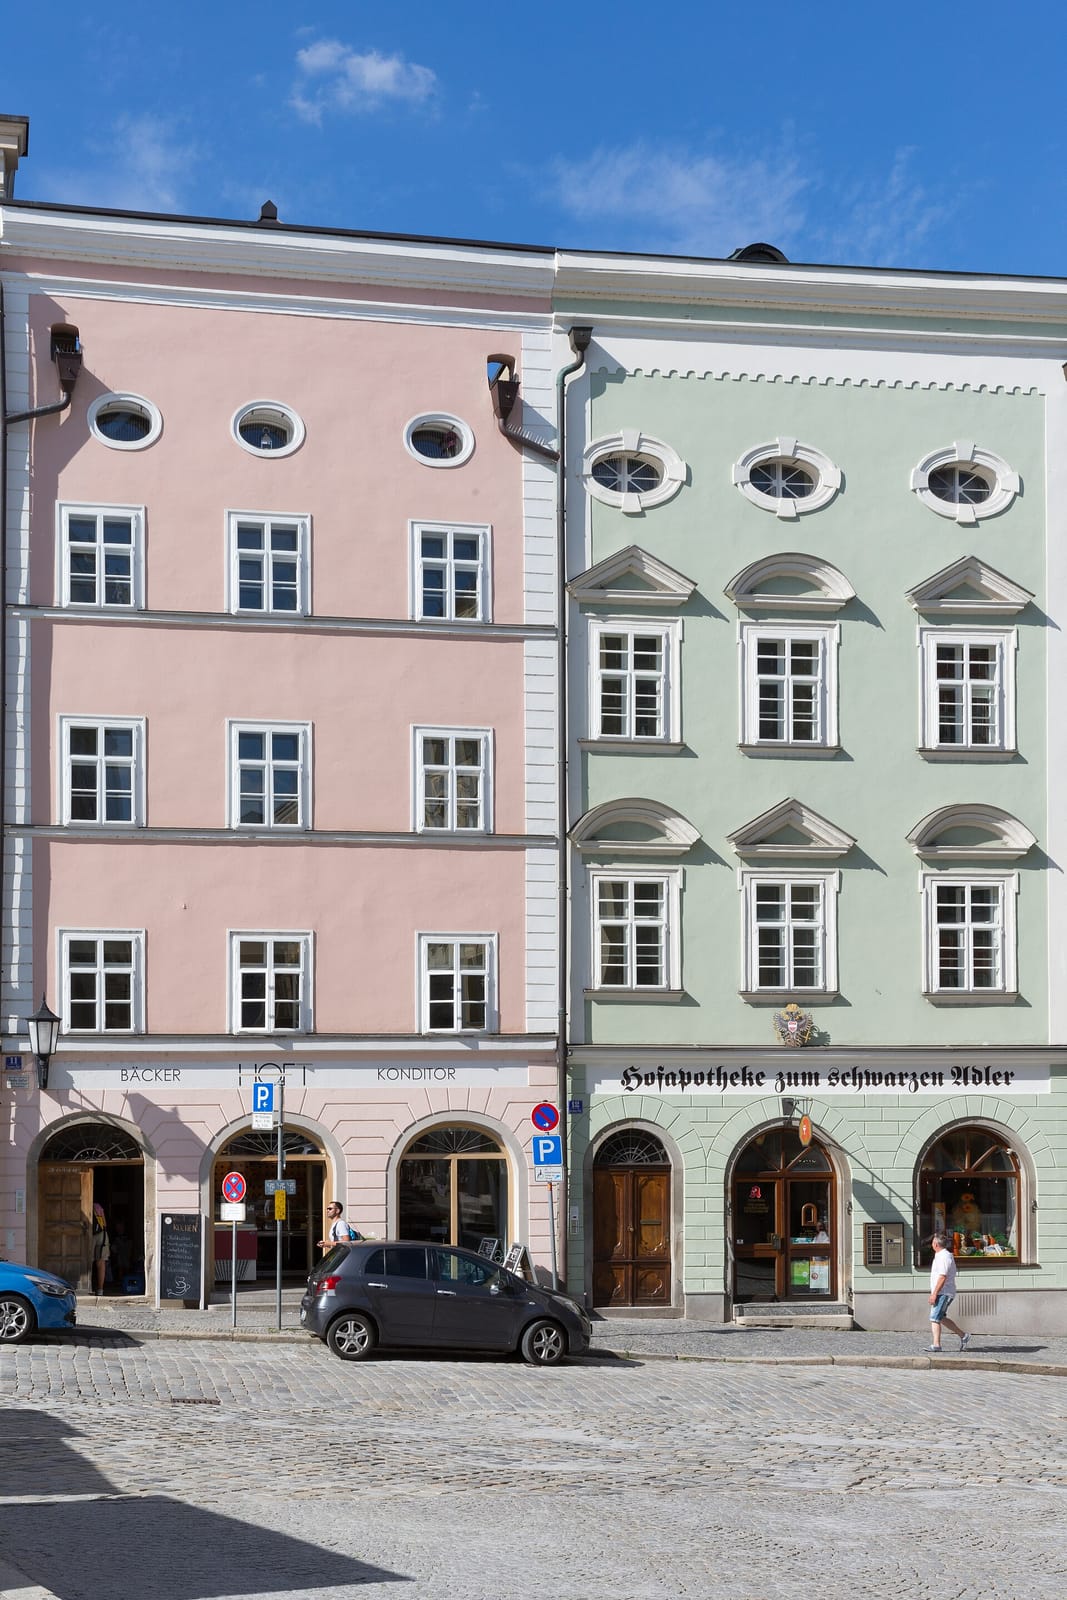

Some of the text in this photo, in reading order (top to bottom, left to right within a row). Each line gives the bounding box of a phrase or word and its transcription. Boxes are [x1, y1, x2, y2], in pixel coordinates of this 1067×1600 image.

[121, 1066, 181, 1081] BÄCKER
[377, 1067, 456, 1081] KONDITOR
[620, 1065, 766, 1093] Hofapotheke
[775, 1070, 820, 1093] zum
[951, 1065, 1015, 1087] Adler
[257, 1086, 269, 1109] P
[539, 1139, 555, 1162] P
